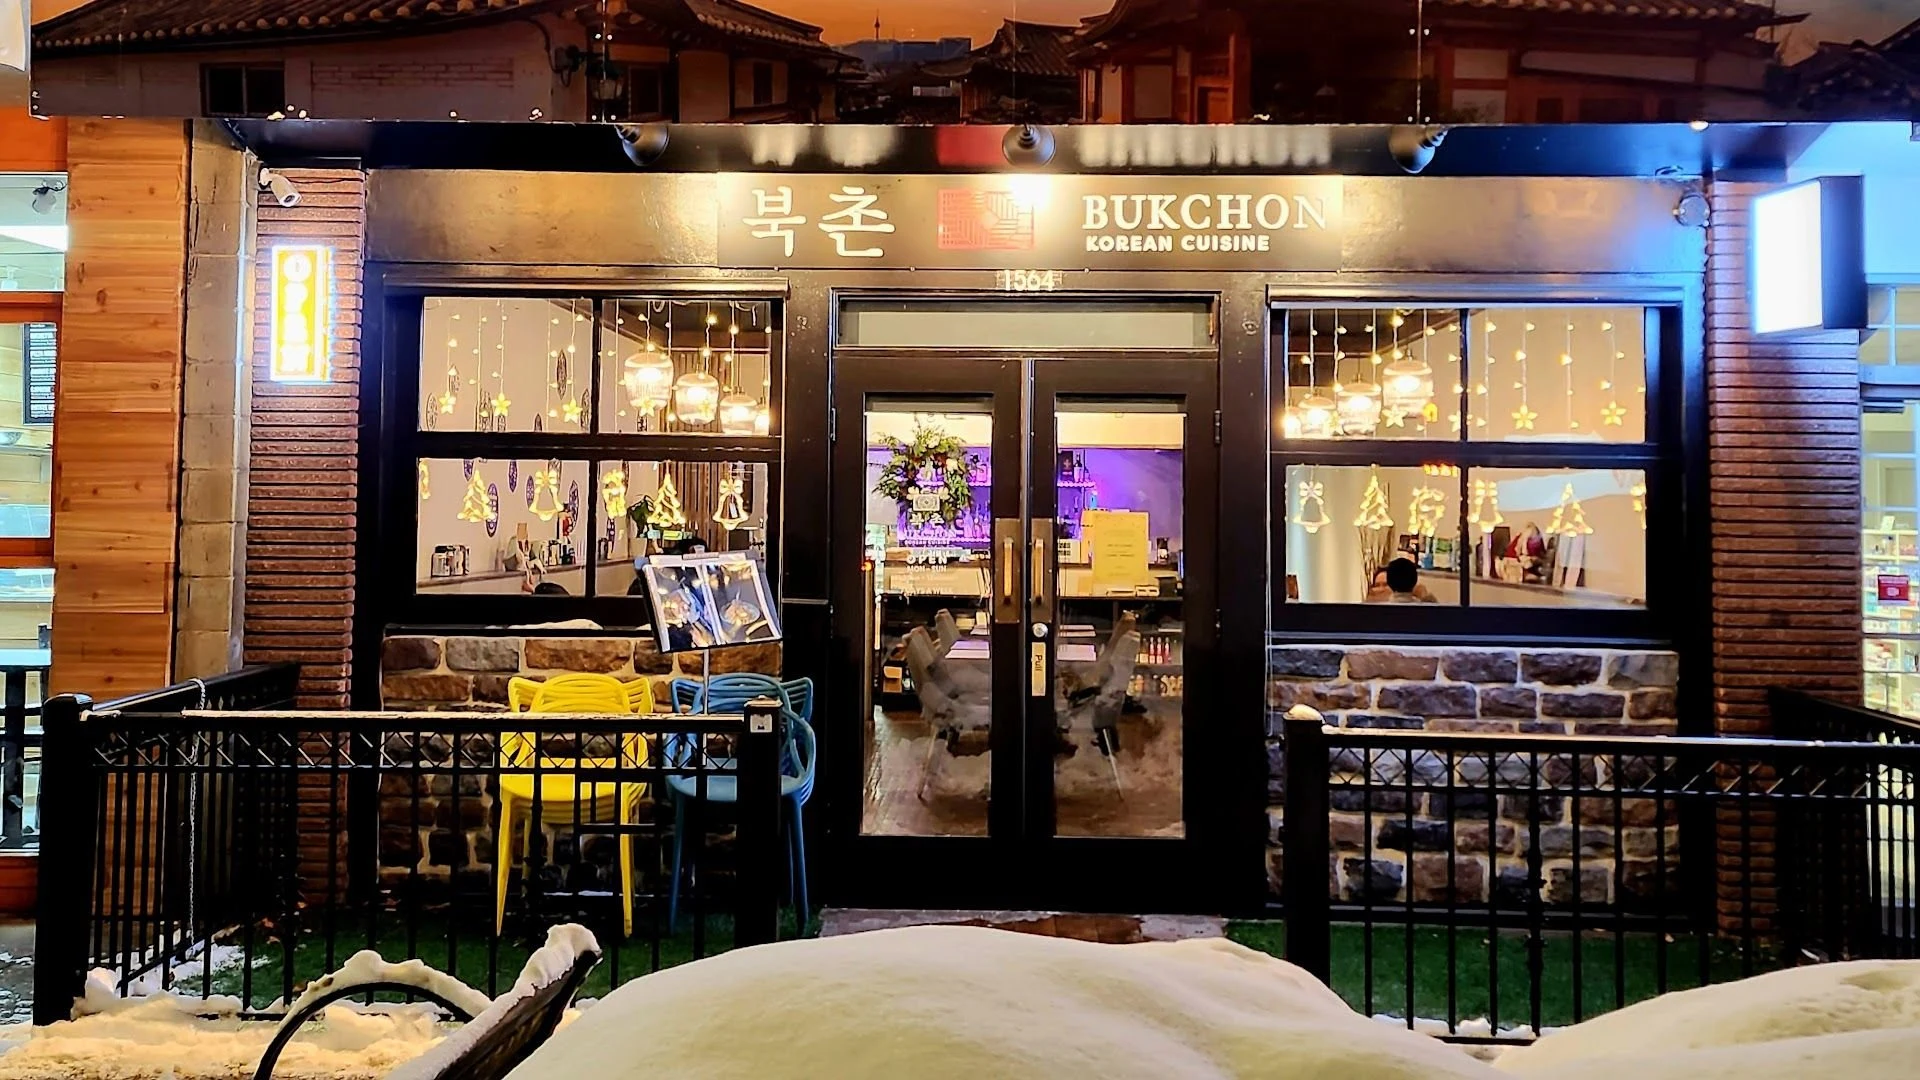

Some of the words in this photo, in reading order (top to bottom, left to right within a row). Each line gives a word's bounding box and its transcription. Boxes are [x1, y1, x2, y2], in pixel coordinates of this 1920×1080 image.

[1082, 193, 1329, 229] BUKCHON
[742, 186, 895, 257] 북촌
[1086, 235, 1173, 252] KOREAN
[1181, 235, 1270, 252] CUISINE
[1004, 269, 1054, 291] 1564
[906, 554, 948, 565] OPEN
[1034, 654, 1043, 671] Pull
